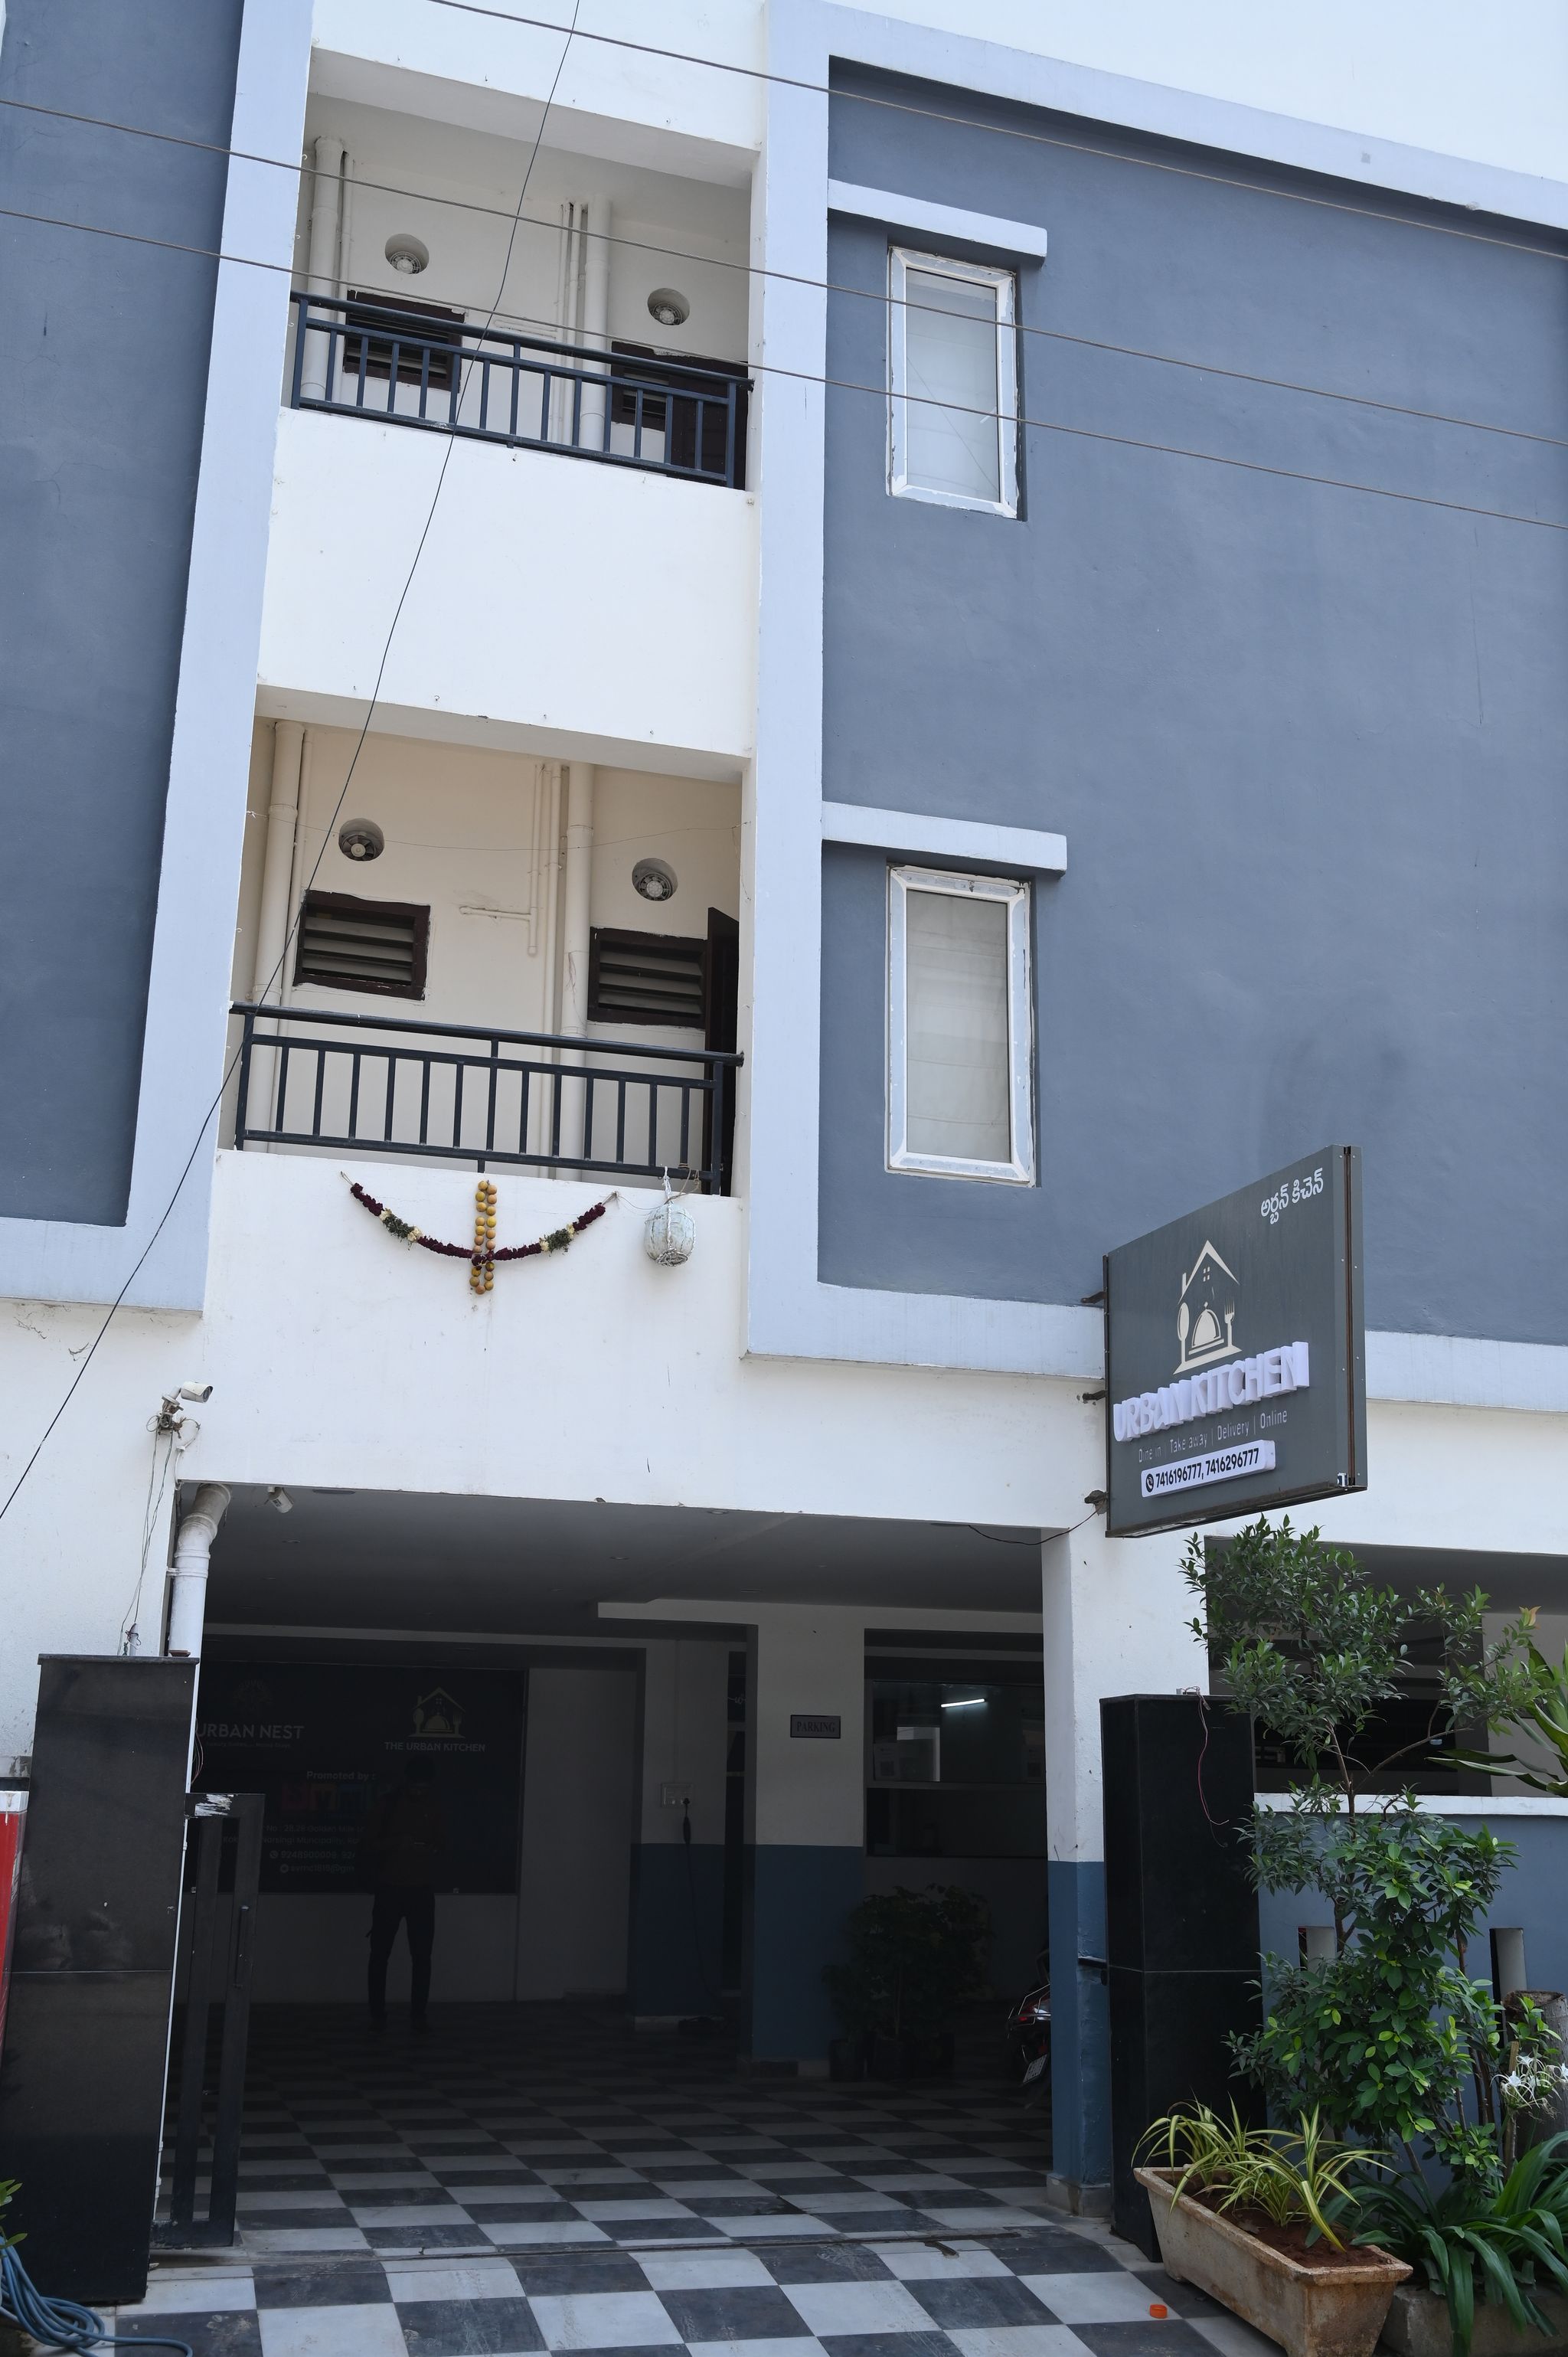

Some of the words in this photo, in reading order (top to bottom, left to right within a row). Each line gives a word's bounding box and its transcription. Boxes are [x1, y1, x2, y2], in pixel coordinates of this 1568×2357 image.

[1261, 1183, 1289, 1224] అర్బన్
[1292, 1167, 1324, 1204] కిచెన్
[1113, 1380, 1194, 1442] URBAN
[1191, 1342, 1309, 1417] KITCHEN
[1170, 1439, 1186, 1453] Take
[1188, 1432, 1207, 1450] away
[1217, 1420, 1250, 1440] Delivery
[1260, 1409, 1288, 1429] Online
[1205, 1447, 1259, 1475] 7416296777
[260, 1724, 305, 1740] NEST
[797, 1721, 835, 1732] PARKING
[384, 1741, 404, 1751] THE
[406, 1741, 442, 1751] URBAN
[443, 1743, 486, 1752] KITCHEN
[306, 1770, 354, 1780] Promoted
